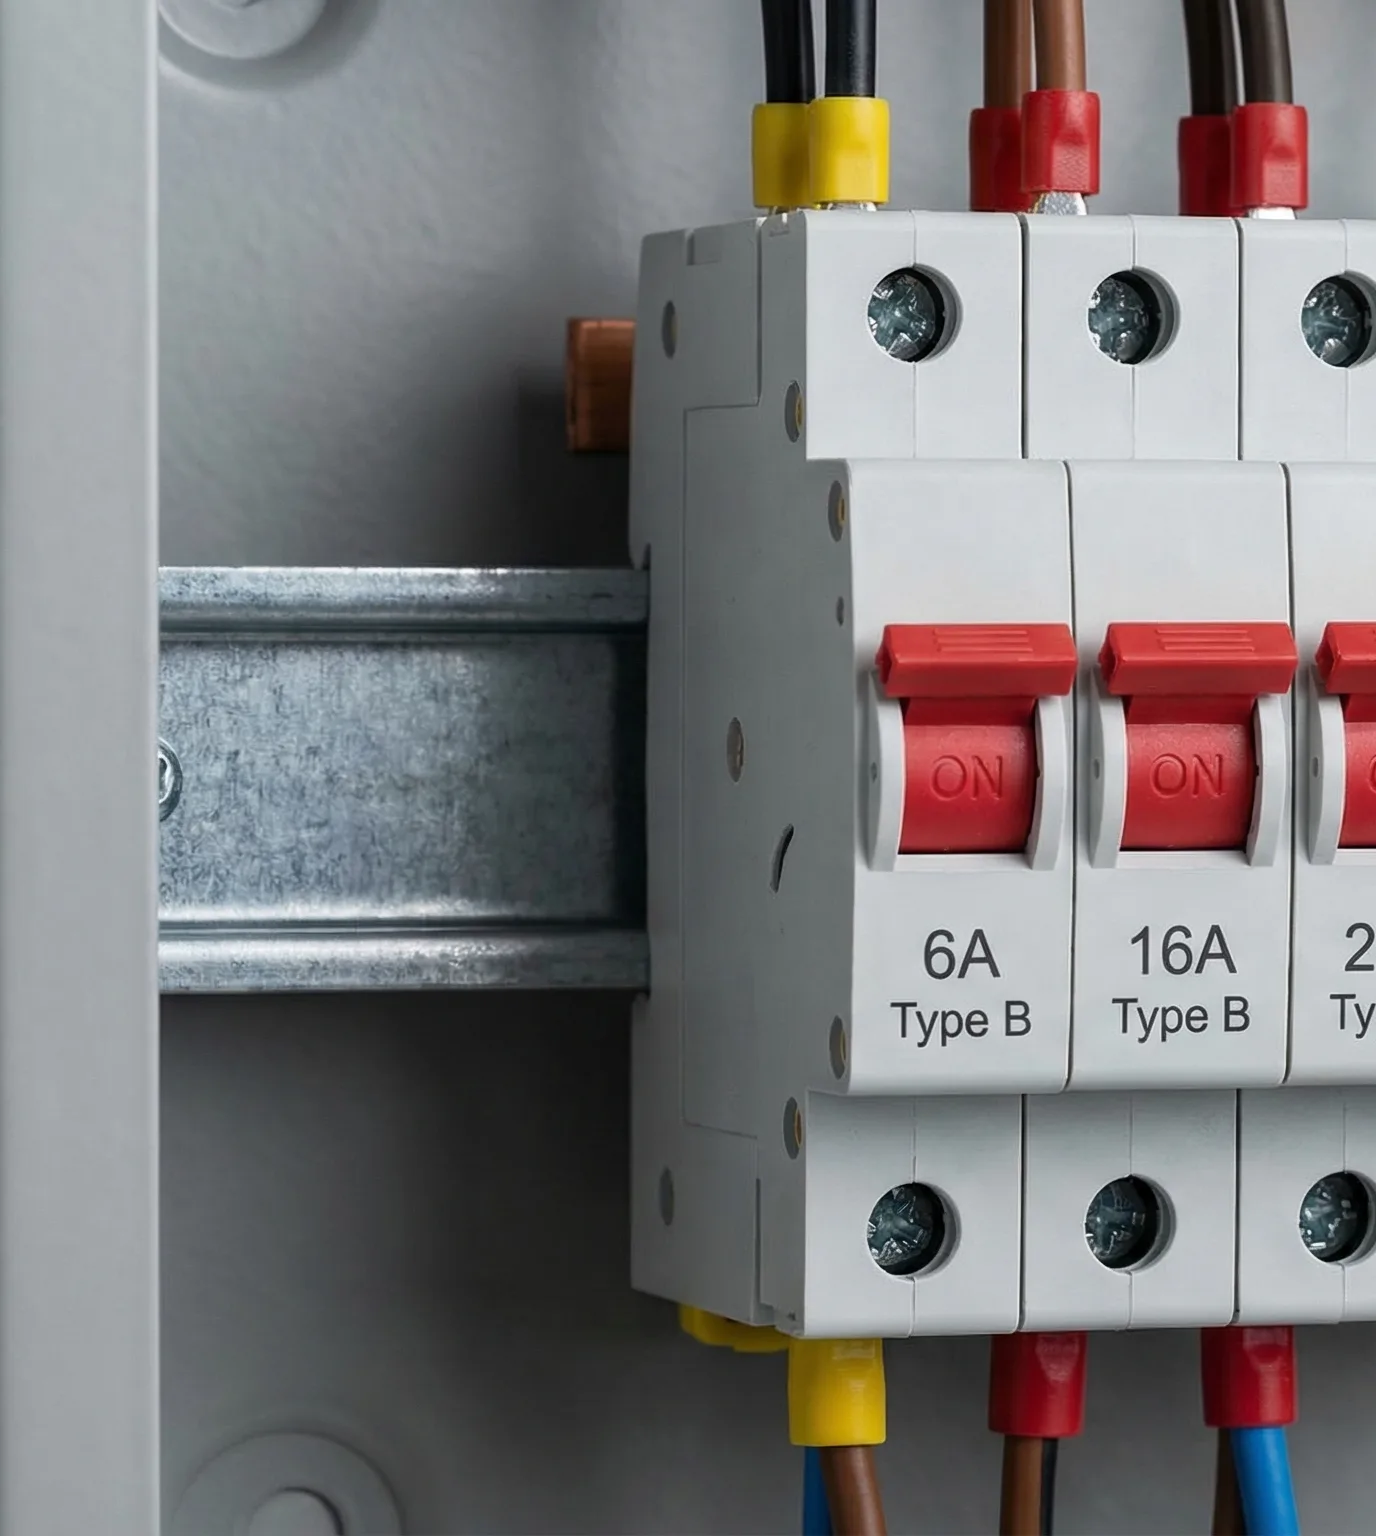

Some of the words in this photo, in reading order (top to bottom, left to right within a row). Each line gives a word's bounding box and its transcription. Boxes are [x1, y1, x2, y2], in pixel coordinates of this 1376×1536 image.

[931, 754, 1004, 801] ON
[1150, 752, 1224, 799] ON
[923, 928, 1001, 980] 6A
[1130, 924, 1238, 976] 16A
[889, 1001, 989, 1048] Type
[1004, 1000, 1032, 1037] B
[1111, 997, 1209, 1044] Type
[1223, 995, 1250, 1033] B
